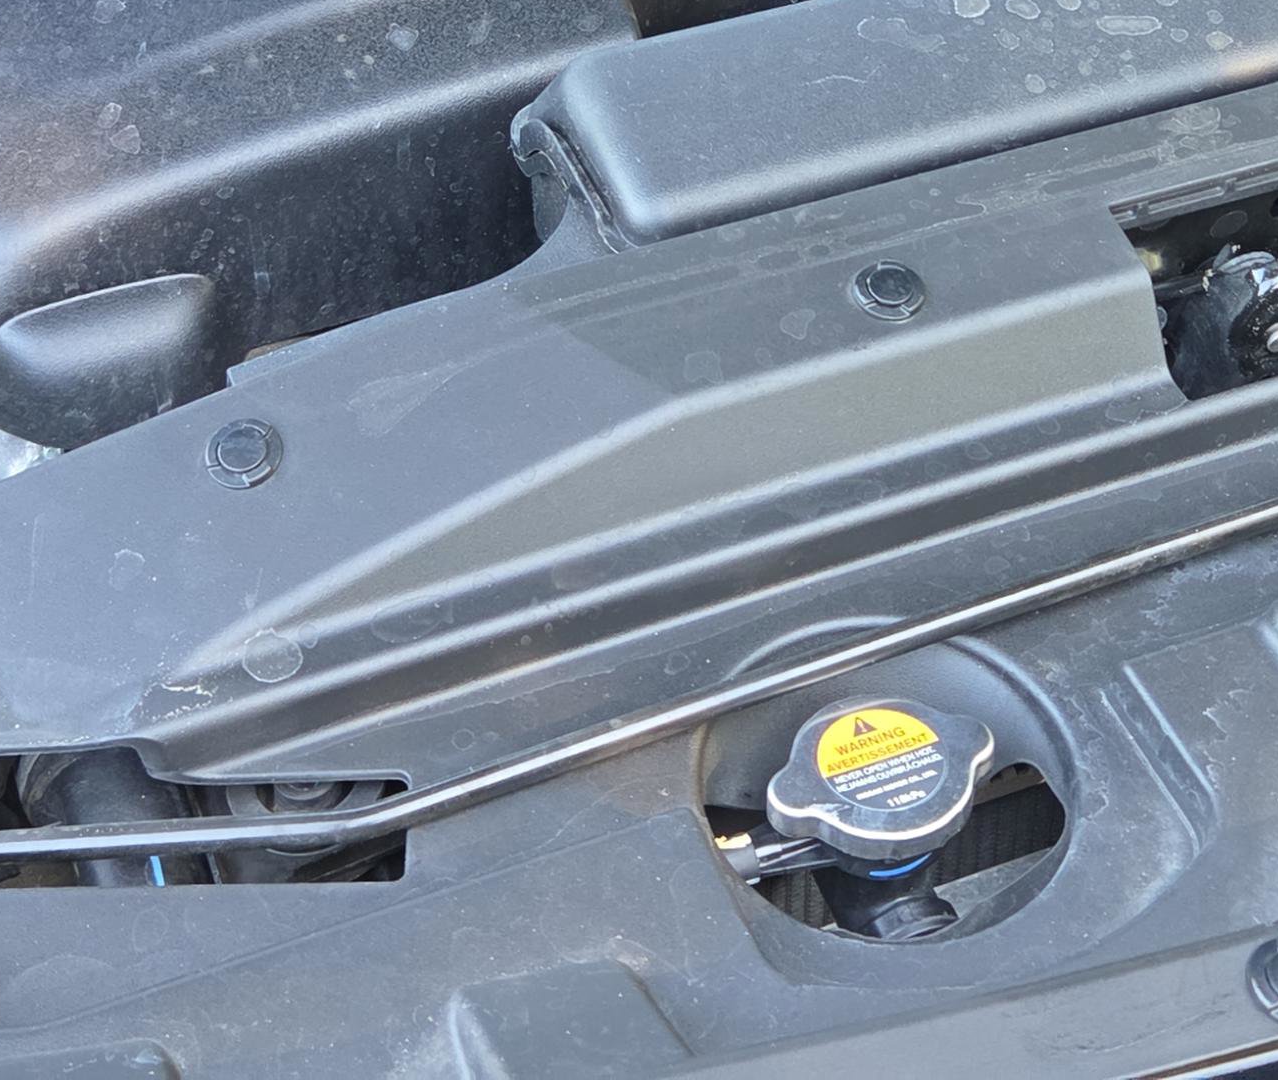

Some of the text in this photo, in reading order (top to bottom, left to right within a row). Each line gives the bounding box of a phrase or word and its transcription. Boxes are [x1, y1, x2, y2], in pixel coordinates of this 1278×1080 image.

[827, 733, 929, 773] AVERTISSEMENT
[834, 726, 906, 756] WARNING
[834, 770, 863, 783] NEVER
[864, 762, 888, 774] OPEN
